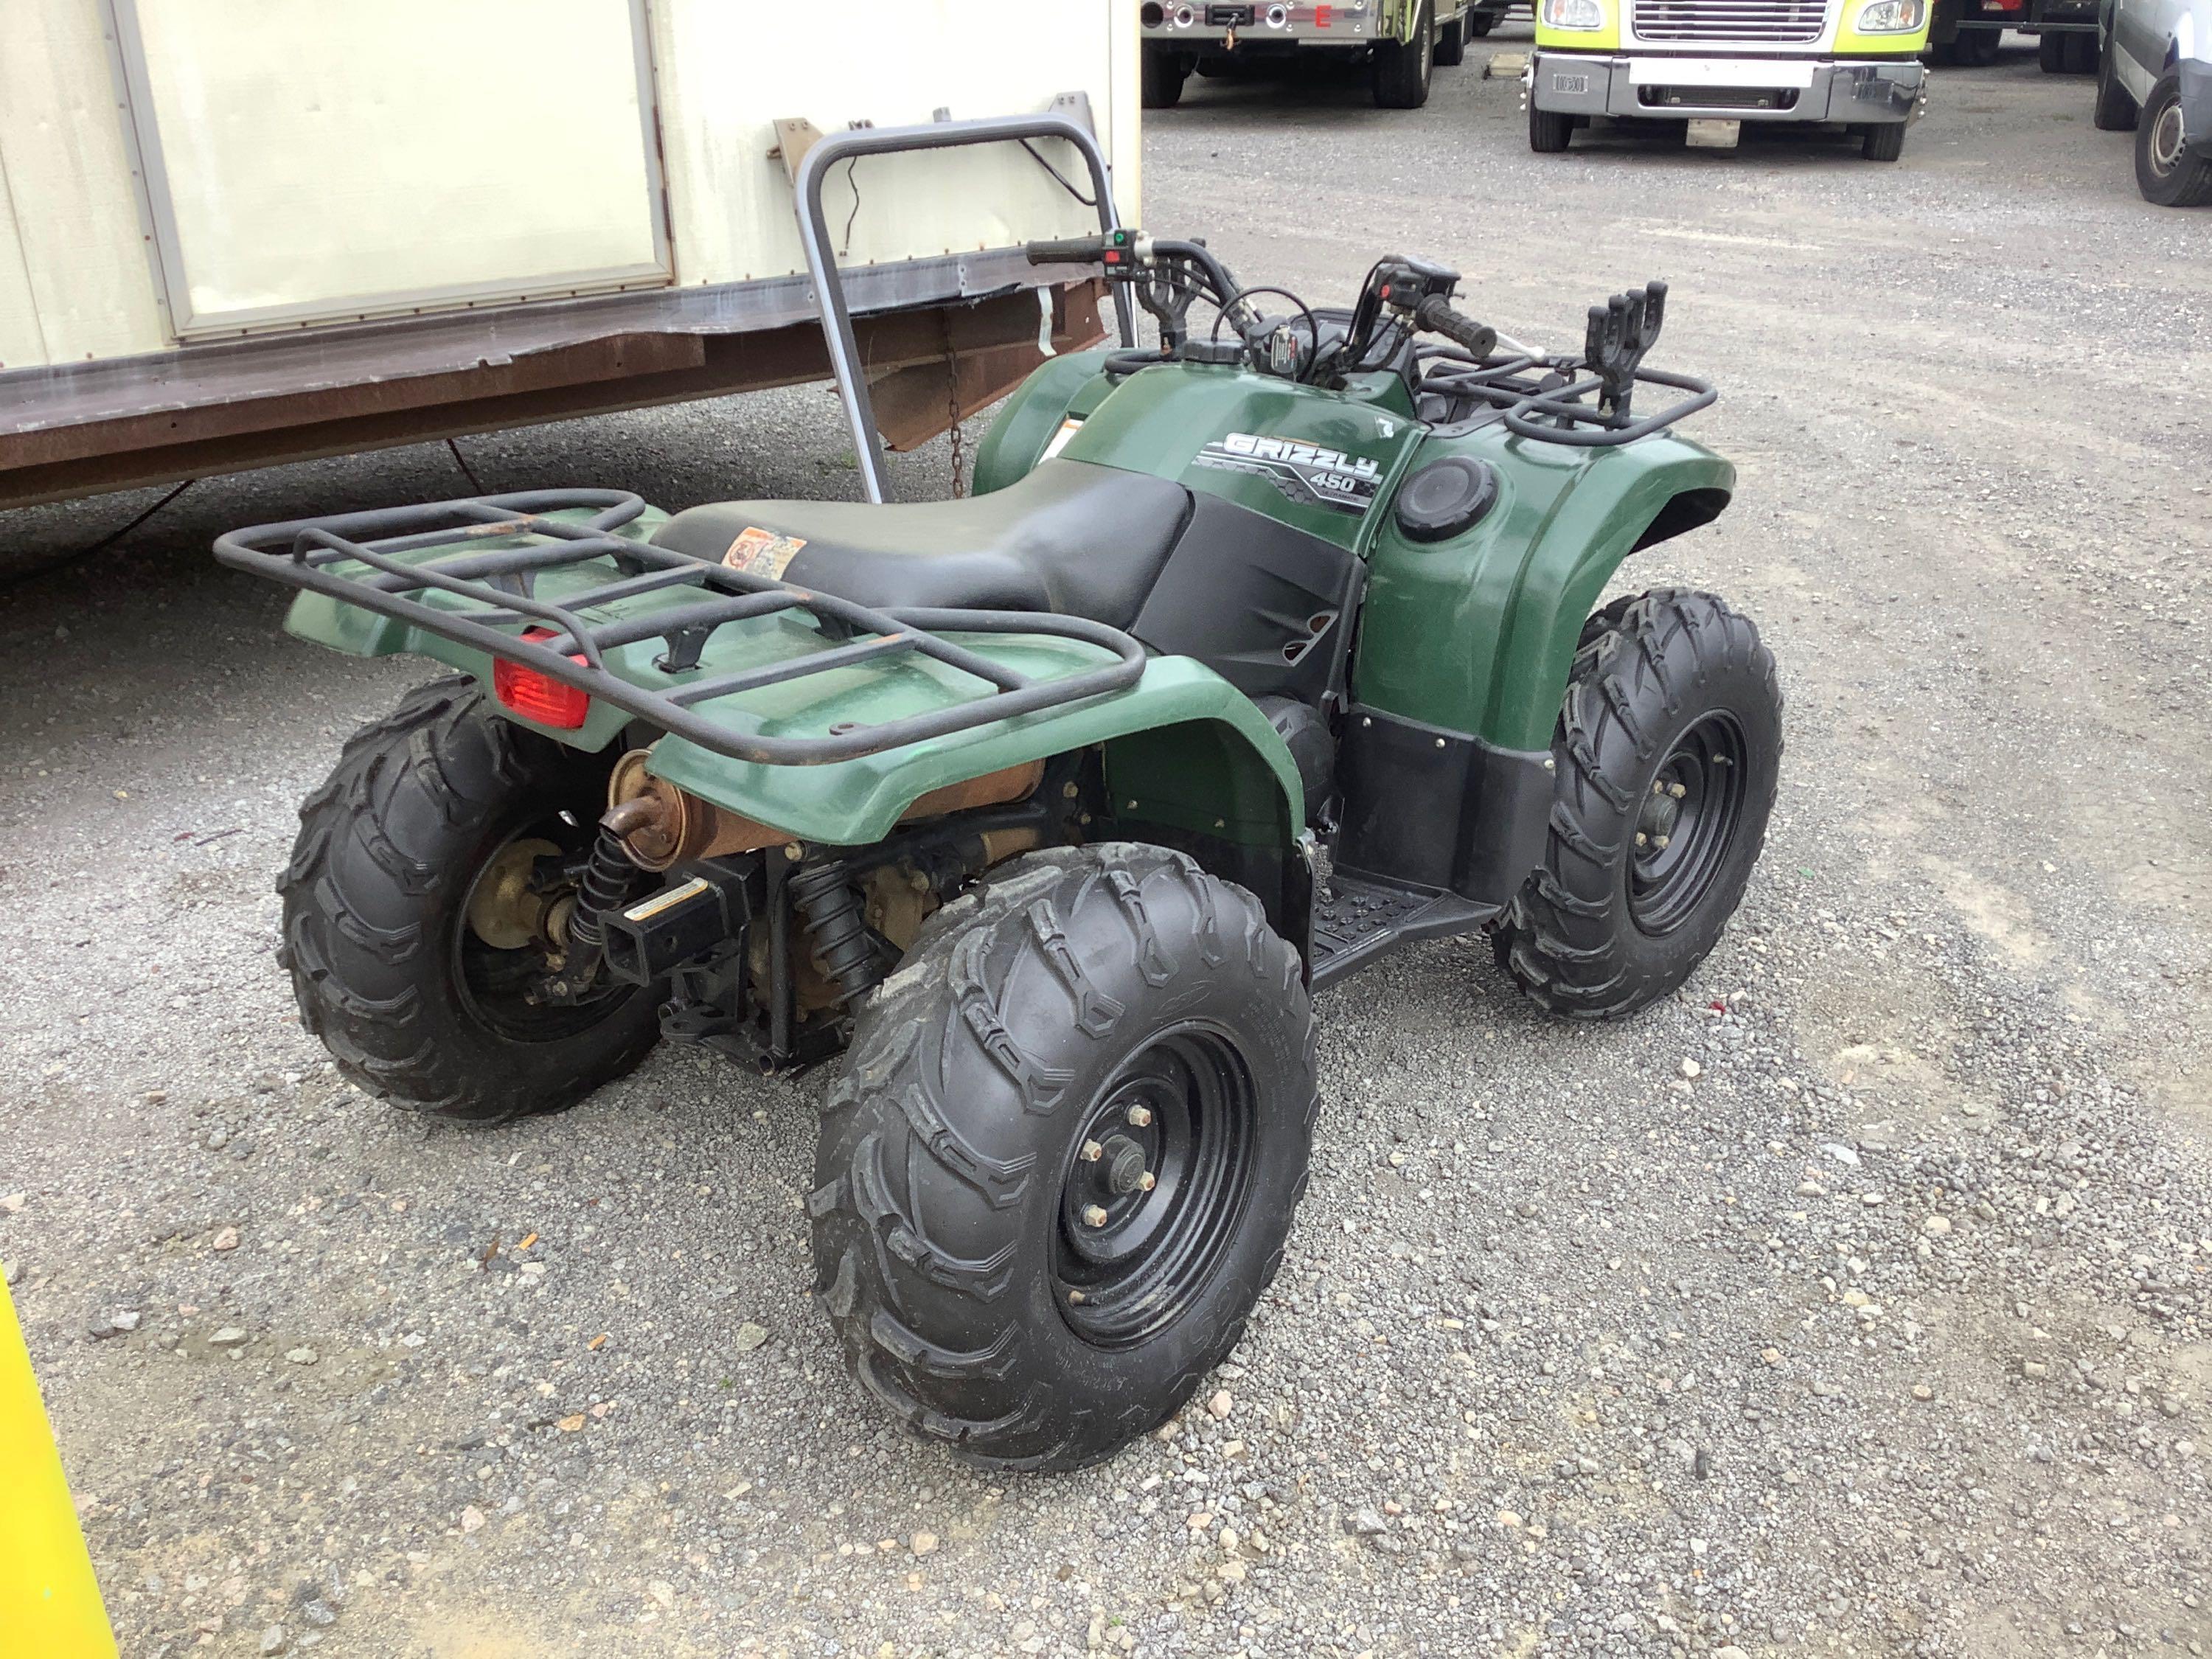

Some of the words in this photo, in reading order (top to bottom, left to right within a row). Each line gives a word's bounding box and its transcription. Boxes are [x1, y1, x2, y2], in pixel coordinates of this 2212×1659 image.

[1315, 4, 1332, 27] E
[1224, 433, 1380, 479] GRIZZLY
[1310, 472, 1356, 492] 450
